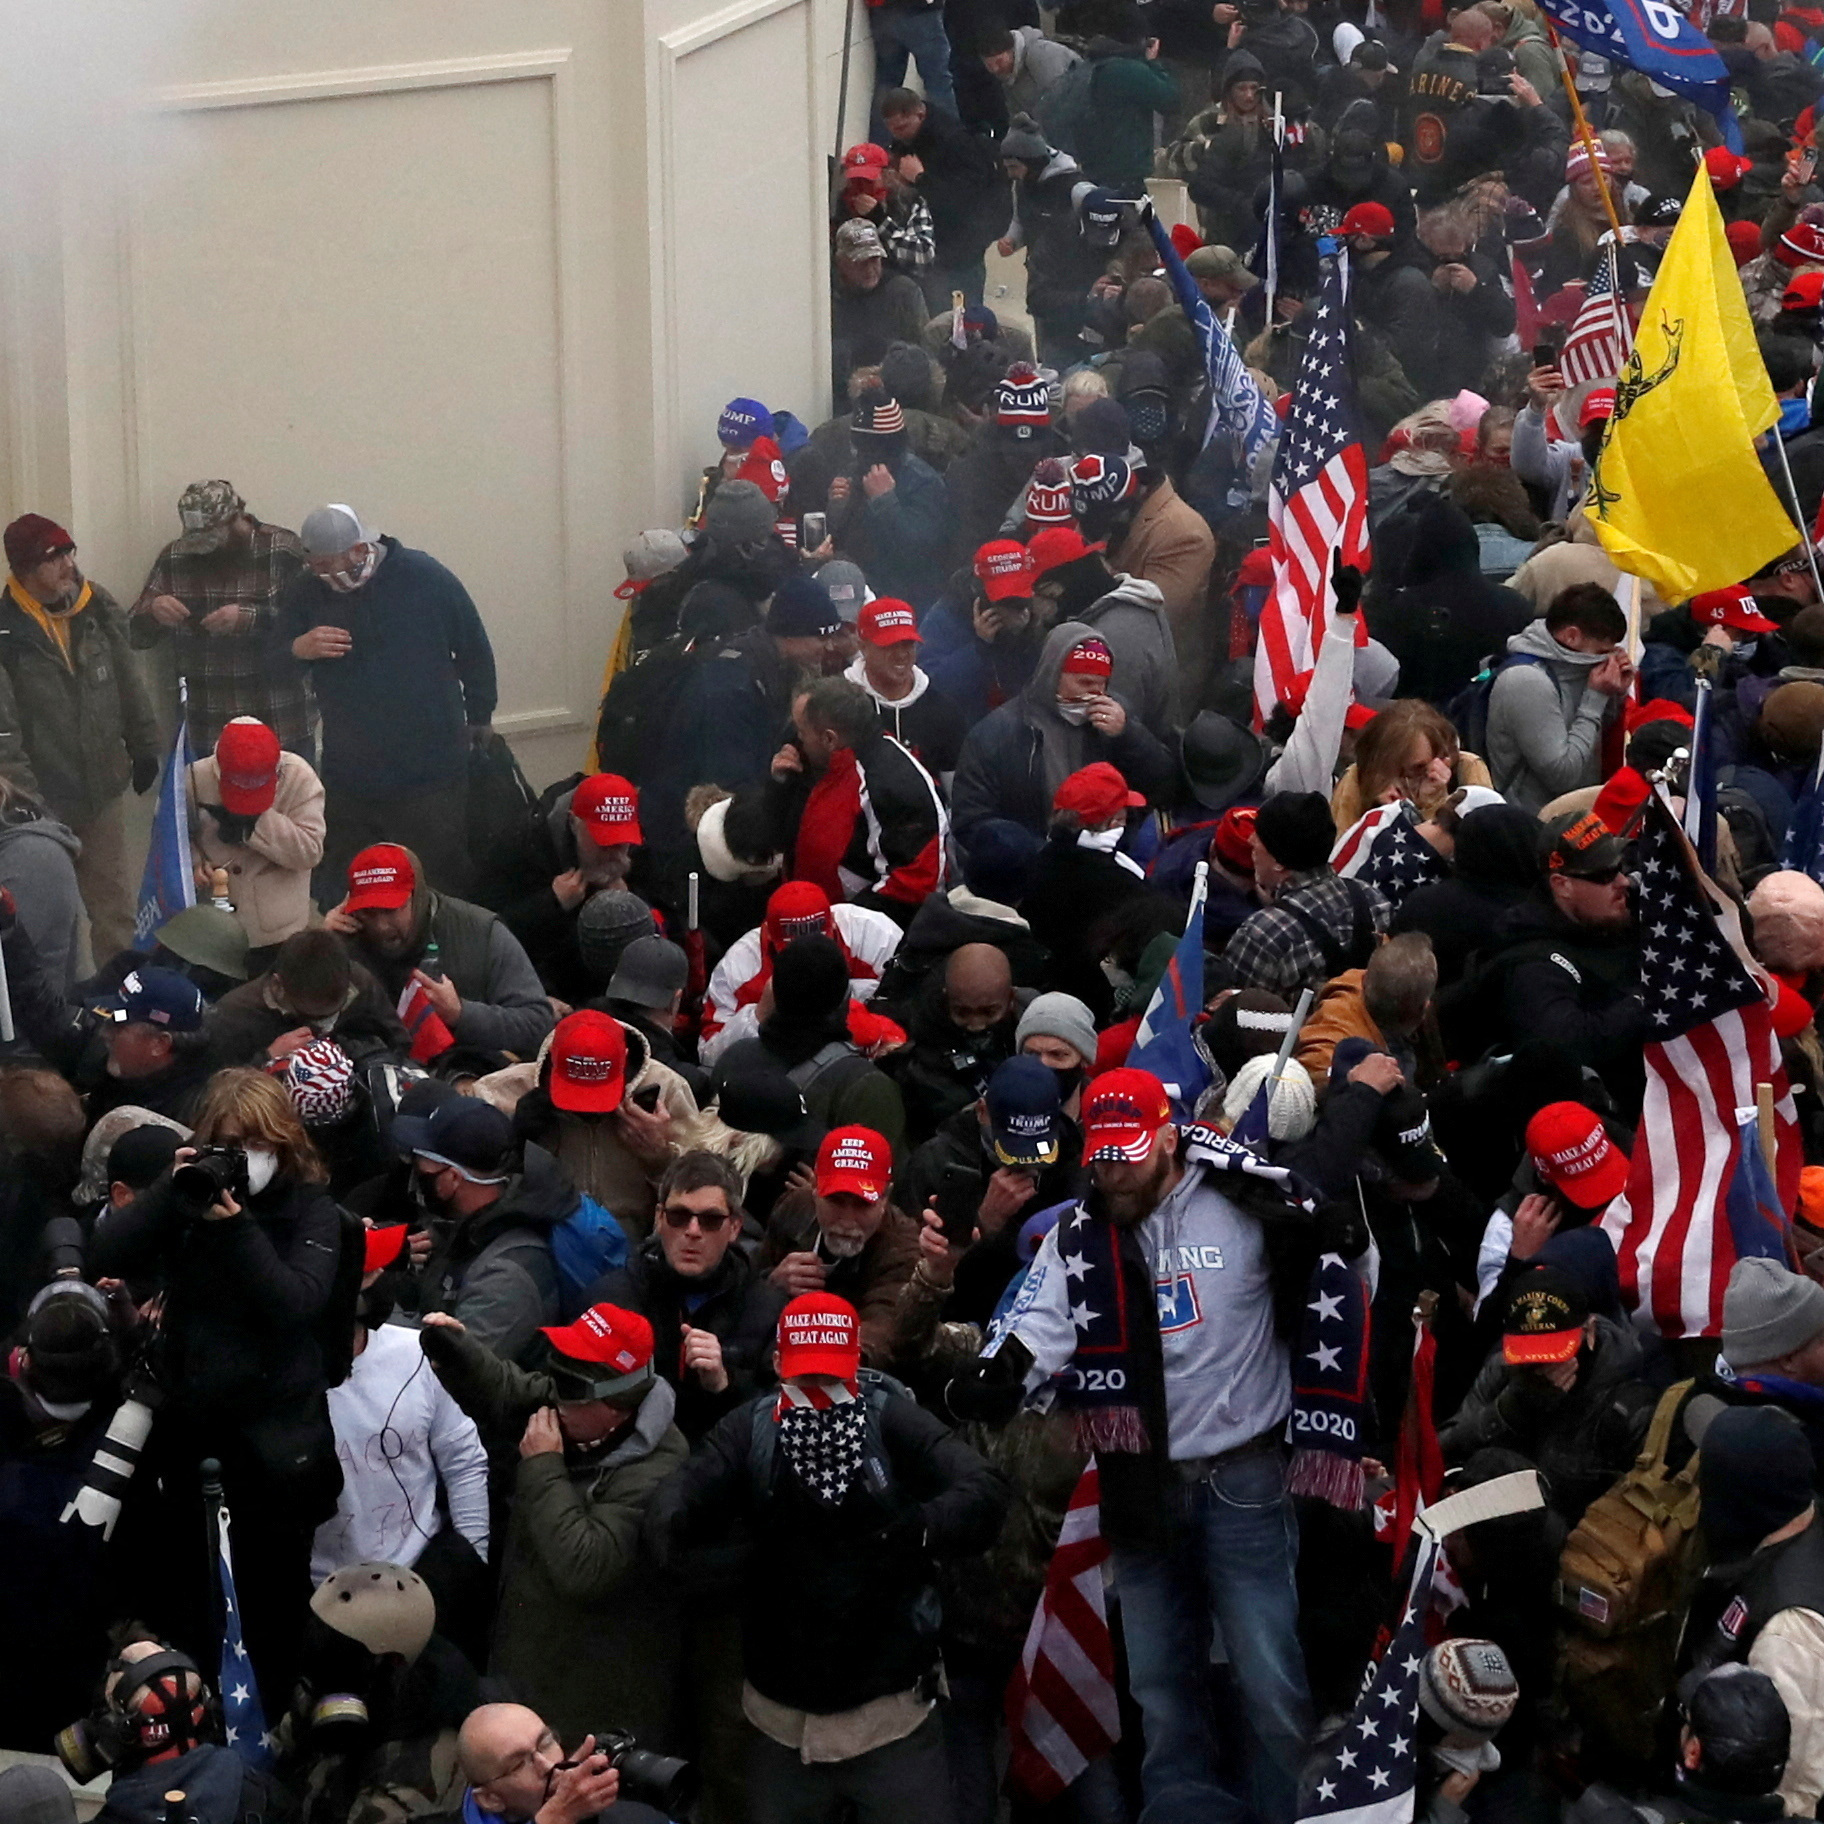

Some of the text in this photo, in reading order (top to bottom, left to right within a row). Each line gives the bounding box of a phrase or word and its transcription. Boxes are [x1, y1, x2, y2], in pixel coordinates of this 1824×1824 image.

[1710, 607, 1724, 618] 45
[841, 1138, 864, 1147] KEEP
[831, 1149, 873, 1160] AMERICA
[1551, 1148, 1575, 1164] MAKE
[784, 1313, 852, 1328] MAKE AMERICA
[1520, 1322, 1556, 1332] VETERAN
[788, 1329, 848, 1345] GREAT AGAIN
[1294, 1409, 1355, 1440] 2020
